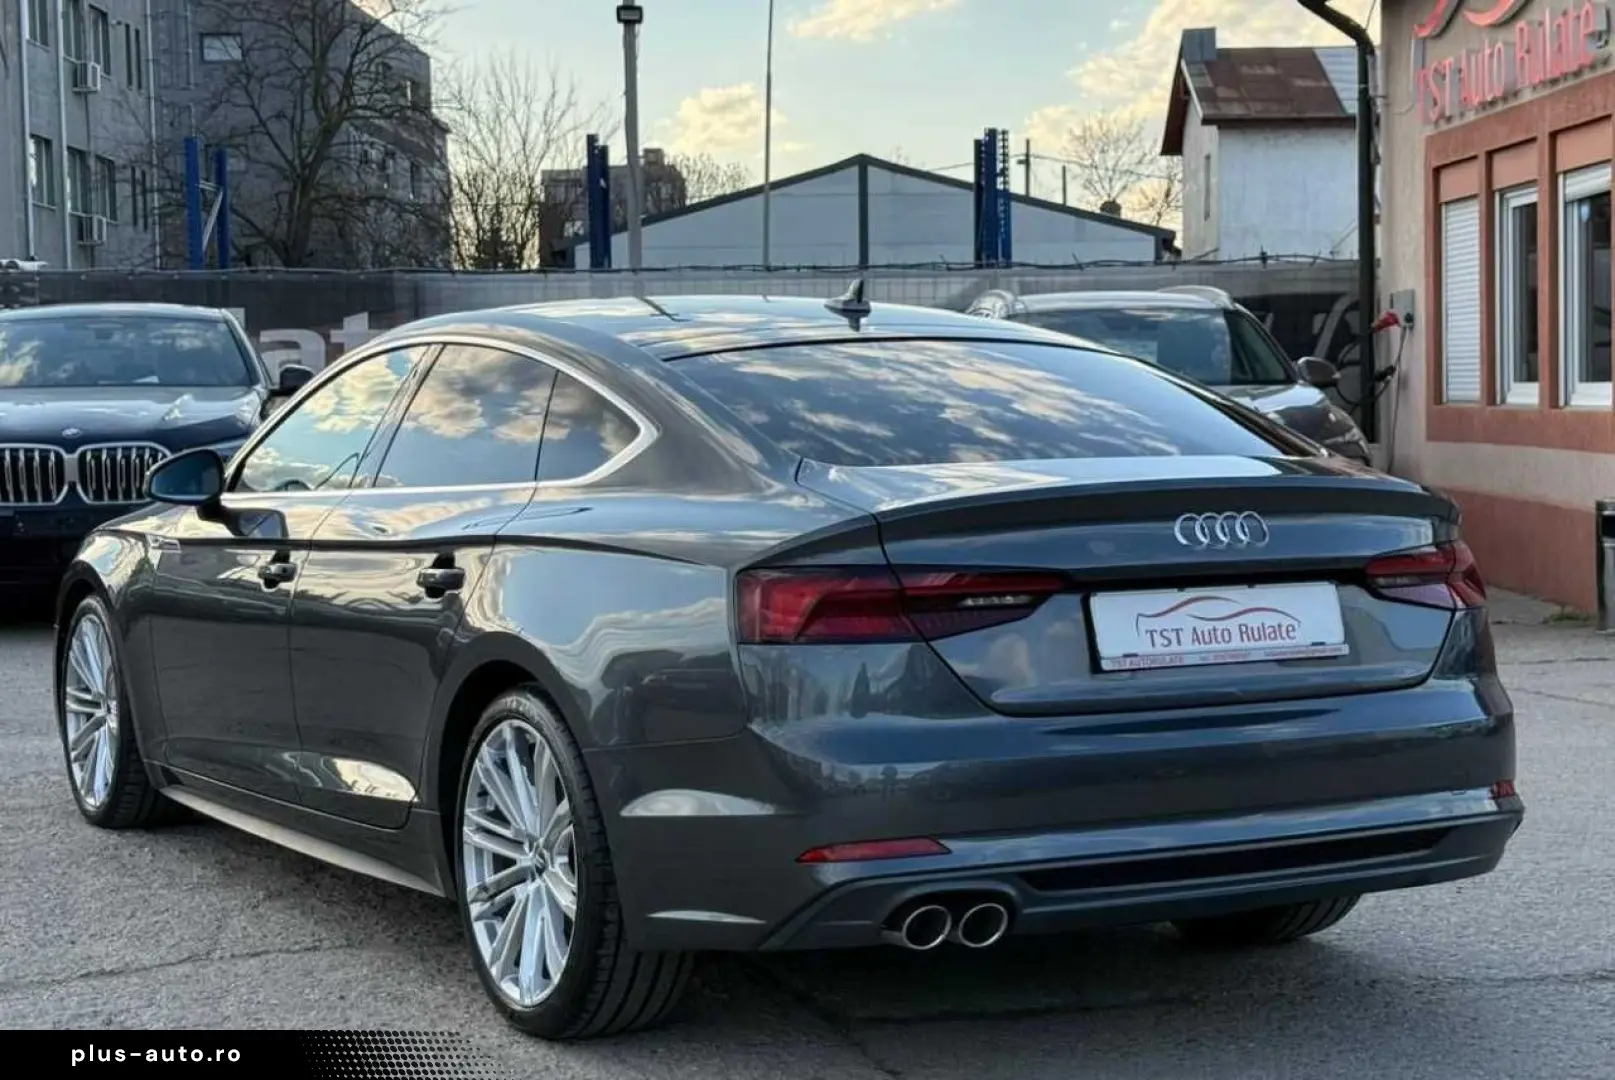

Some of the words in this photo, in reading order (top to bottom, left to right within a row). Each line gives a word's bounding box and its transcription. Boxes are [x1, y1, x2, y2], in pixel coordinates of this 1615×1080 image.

[1415, 57, 1454, 124] TST
[1460, 38, 1505, 107] Auto
[1515, 1, 1596, 88] Rulate
[1145, 628, 1184, 648] TST
[1191, 625, 1232, 646] Auto
[1239, 622, 1297, 643] Rulate
